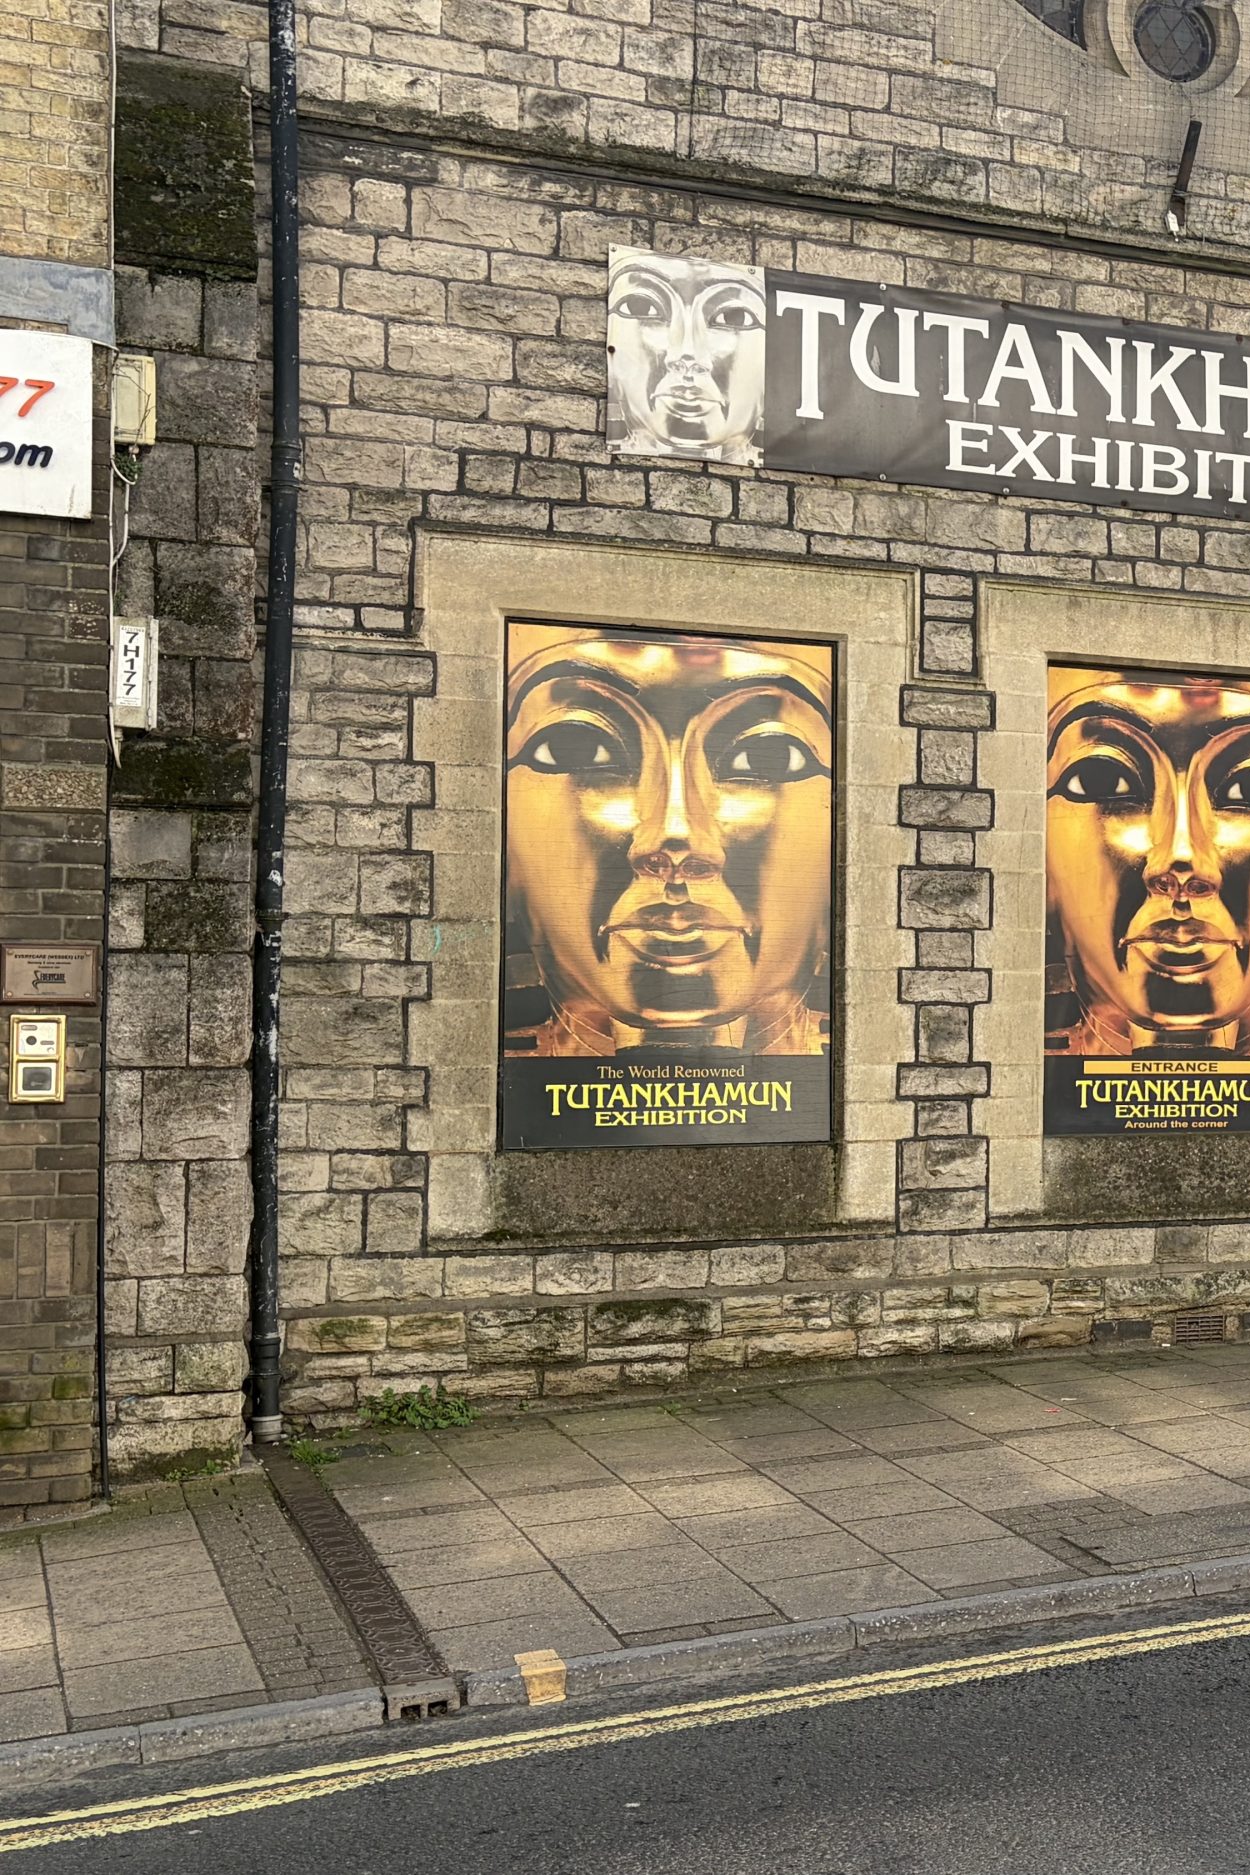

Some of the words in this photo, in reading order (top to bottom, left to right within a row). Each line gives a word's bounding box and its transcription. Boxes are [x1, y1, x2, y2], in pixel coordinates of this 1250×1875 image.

[597, 1065, 624, 1080] The
[629, 1065, 669, 1080] World
[674, 1065, 745, 1079] Renowned
[1131, 1062, 1218, 1073] ENTRANCE
[546, 1081, 792, 1116] TUTANKHAMUN
[594, 1108, 747, 1127] EXHIBITION
[1114, 1103, 1238, 1119] EXHIBITION
[1124, 1120, 1167, 1129] Around
[1170, 1120, 1189, 1129] the
[1191, 1120, 1229, 1128] corner
